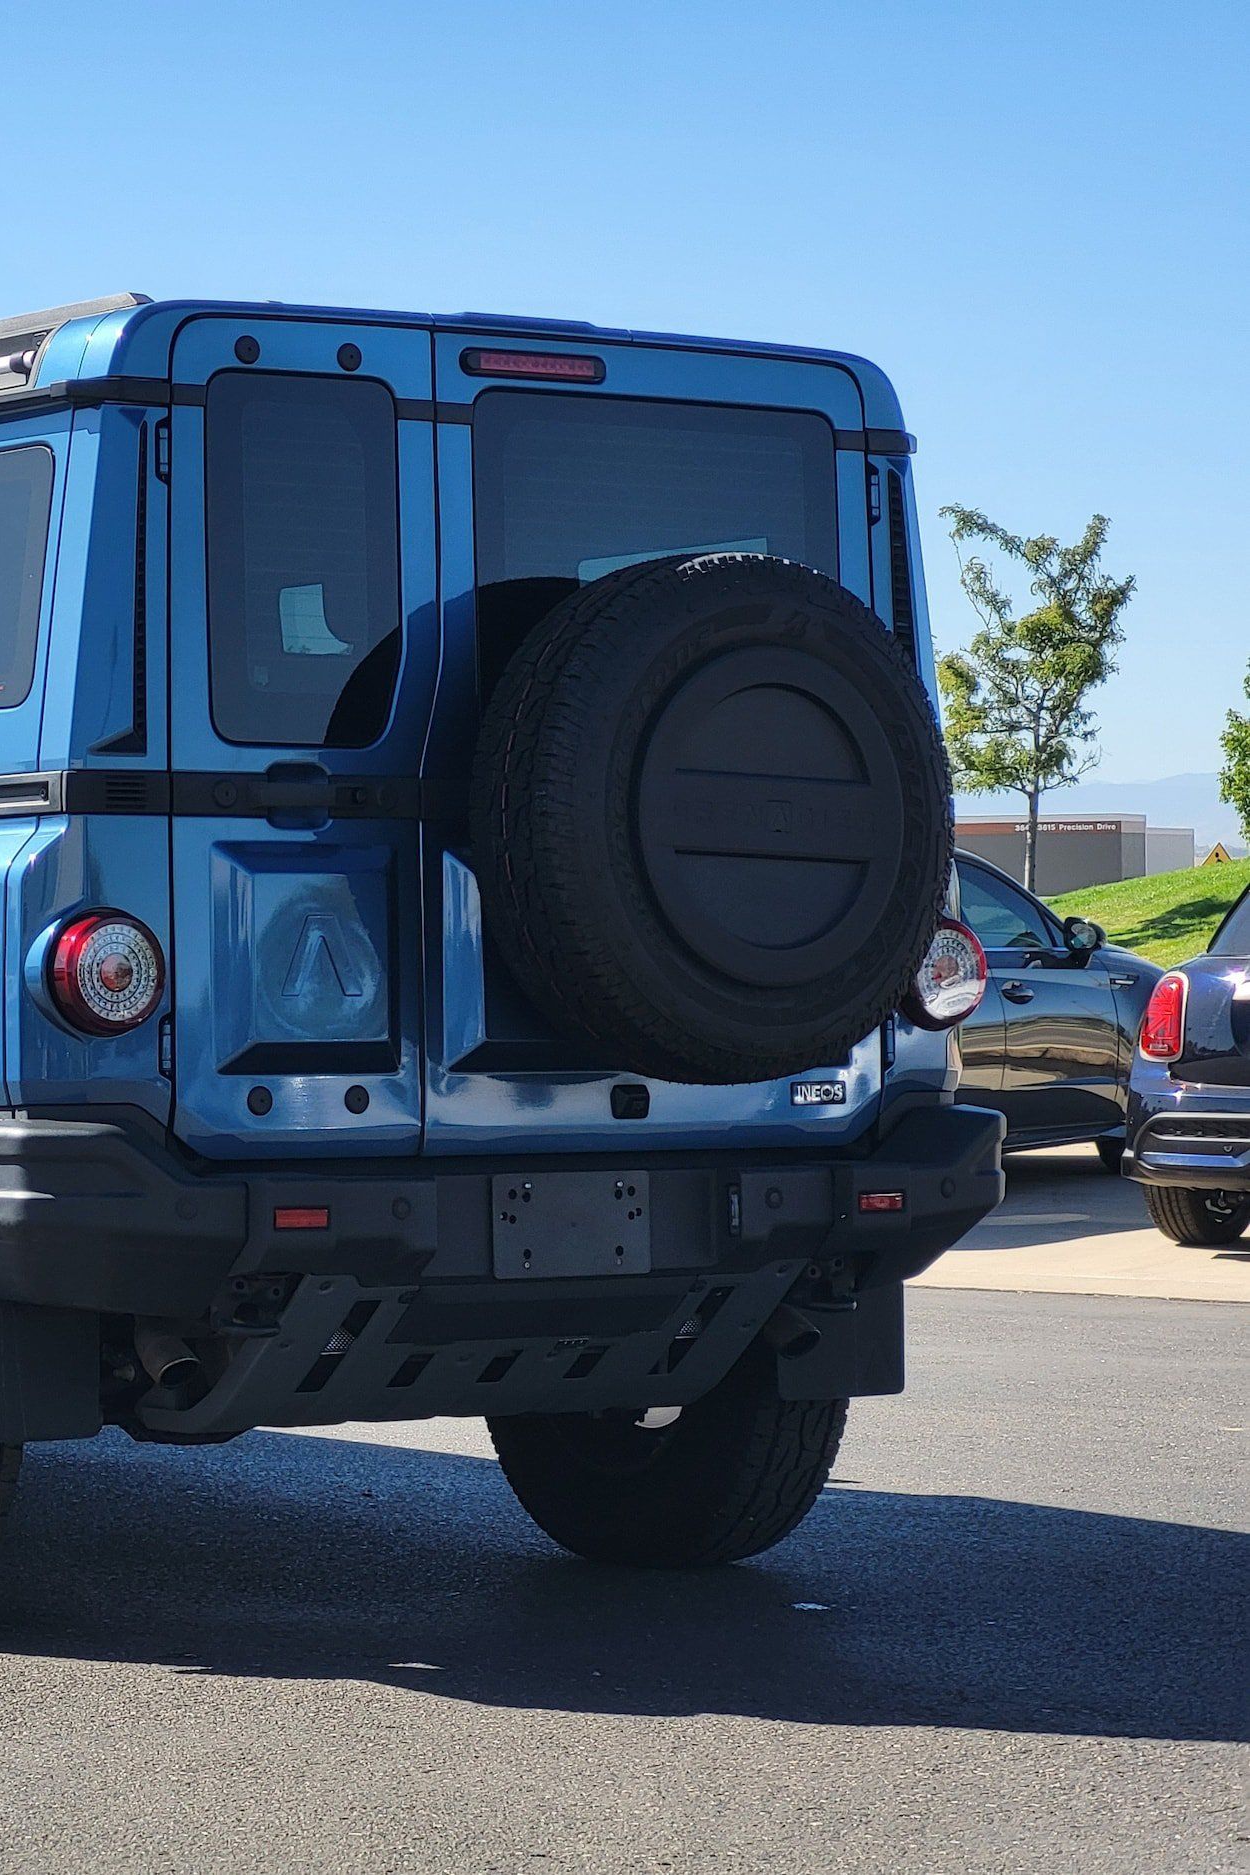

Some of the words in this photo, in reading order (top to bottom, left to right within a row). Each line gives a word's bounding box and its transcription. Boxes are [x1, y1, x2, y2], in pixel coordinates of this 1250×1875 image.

[1058, 823, 1094, 832] Precision
[1096, 822, 1117, 832] Drive
[795, 1083, 843, 1102] INEOS
